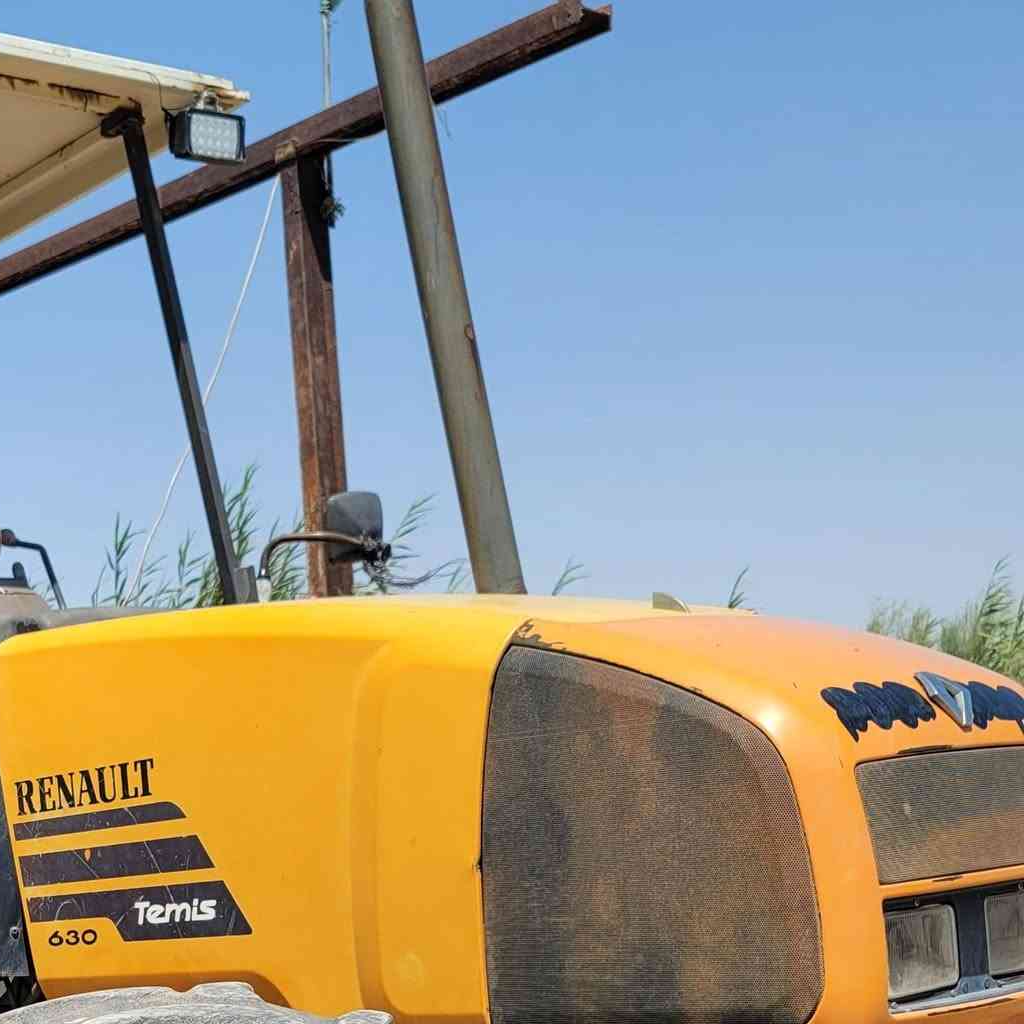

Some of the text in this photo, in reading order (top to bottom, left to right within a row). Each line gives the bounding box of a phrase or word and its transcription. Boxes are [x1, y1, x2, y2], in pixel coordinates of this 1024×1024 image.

[14, 758, 154, 816] RENAULT
[134, 898, 217, 925] Temis
[48, 929, 97, 946] 630
